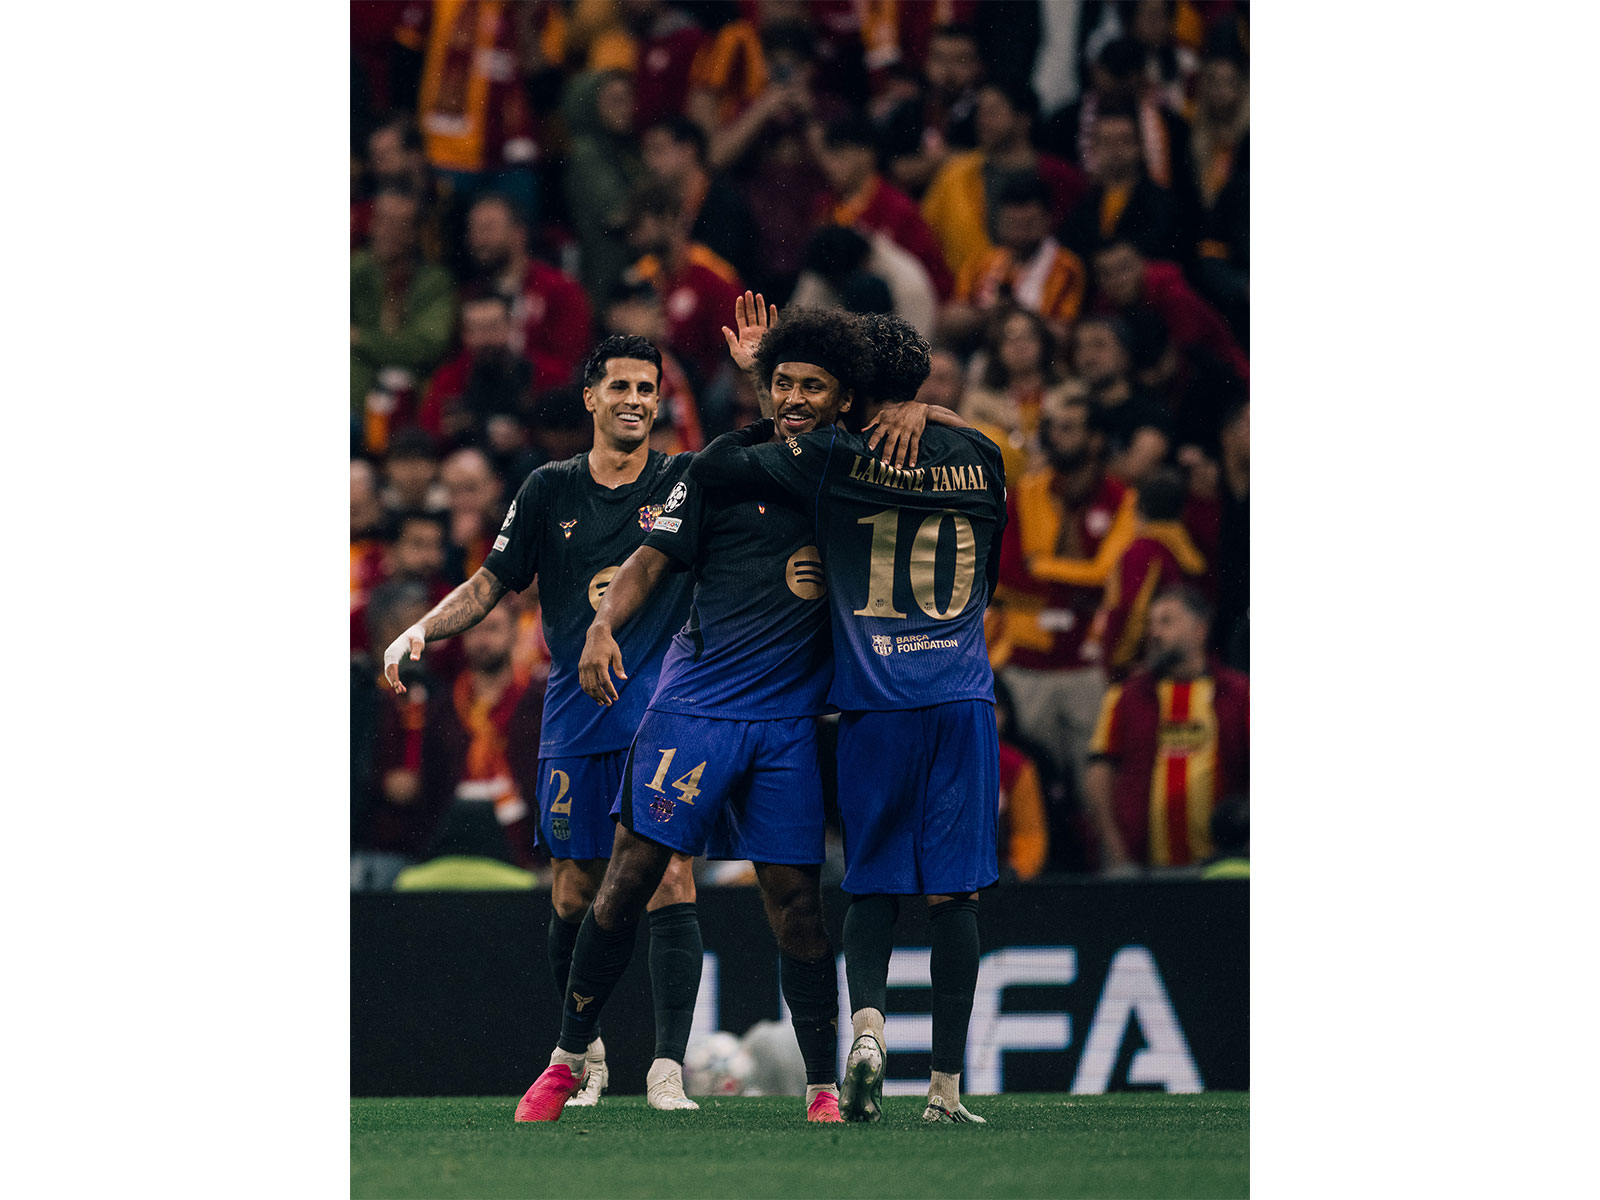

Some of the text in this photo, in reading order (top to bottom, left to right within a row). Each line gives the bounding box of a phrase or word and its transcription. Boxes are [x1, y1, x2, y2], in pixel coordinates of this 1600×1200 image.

[849, 455, 987, 492] LAMINE YAMAL
[853, 505, 976, 620] 10
[896, 634, 929, 644] BARÇA
[897, 639, 959, 653] FOUNDATION
[549, 768, 573, 817] 2
[644, 748, 707, 805] 14
